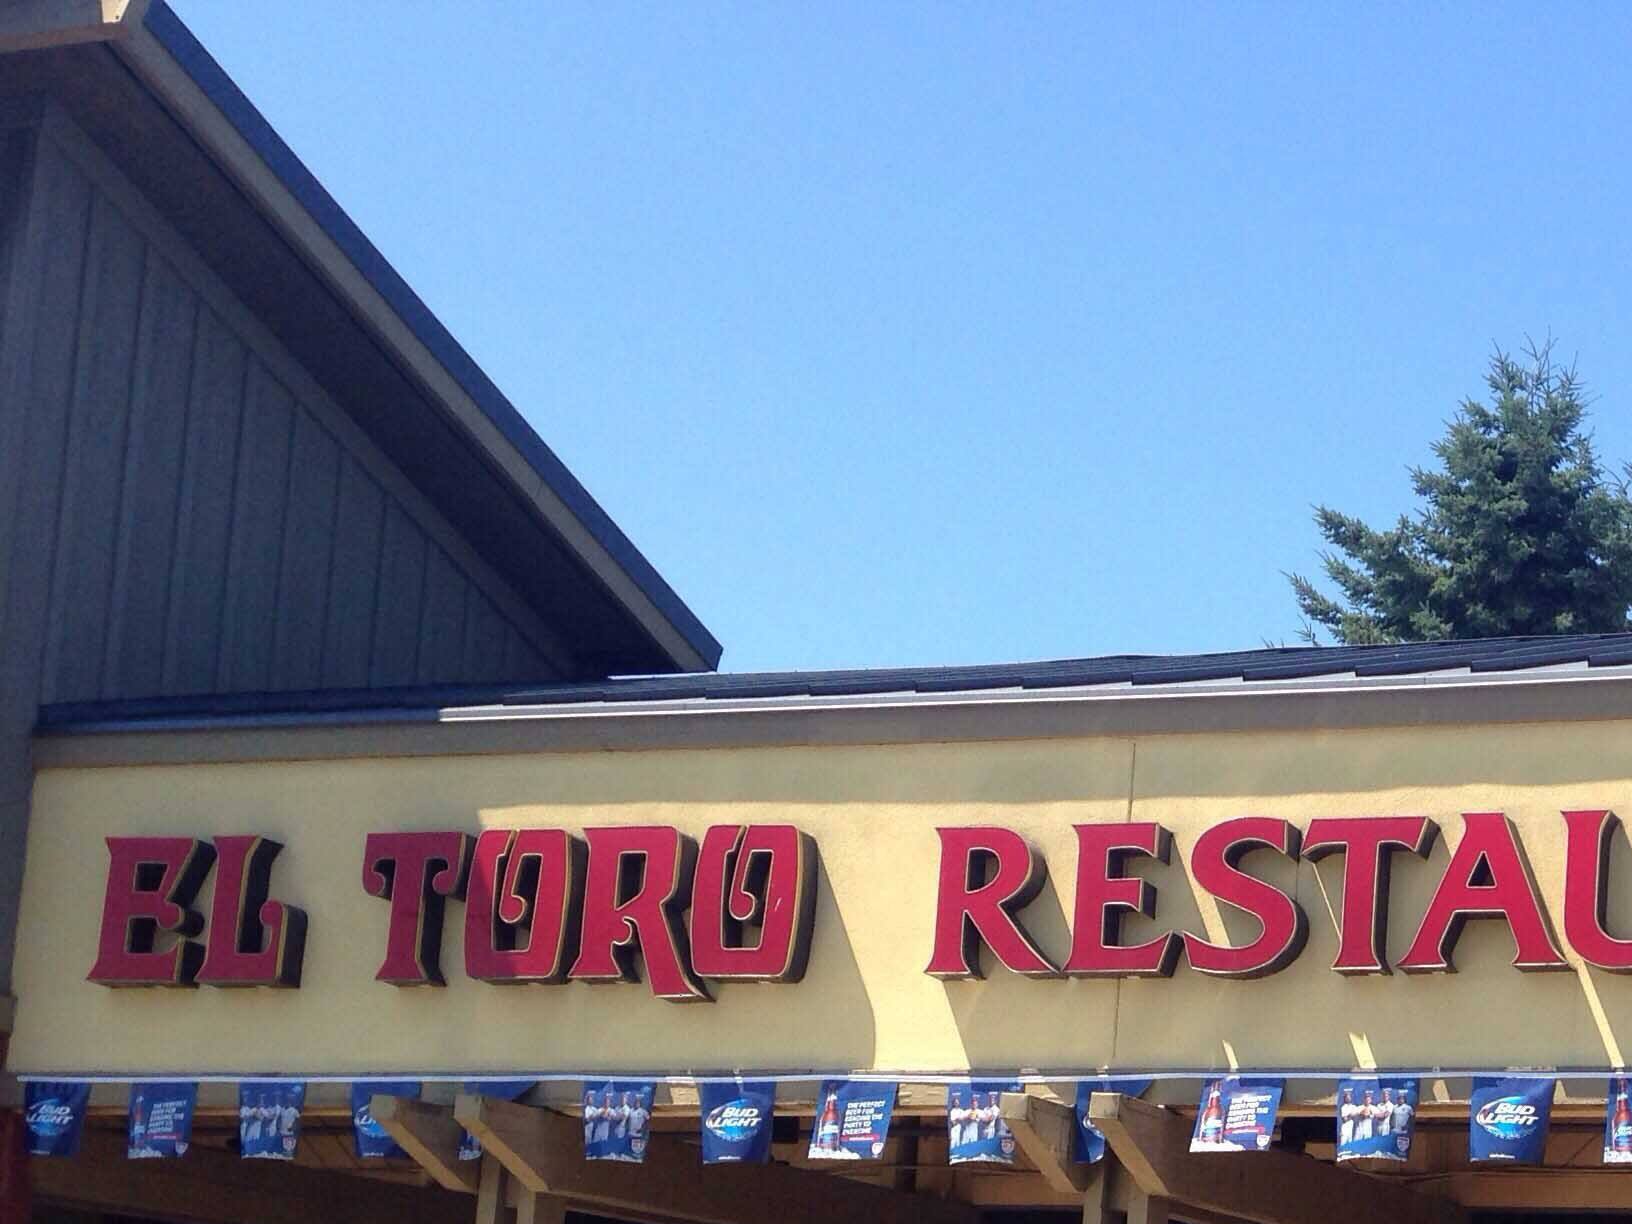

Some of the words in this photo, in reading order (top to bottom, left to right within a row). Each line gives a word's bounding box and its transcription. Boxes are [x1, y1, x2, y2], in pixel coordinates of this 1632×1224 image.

[85, 834, 304, 988] EL
[362, 824, 814, 1001] TORO
[722, 1107, 758, 1118] BUD
[1495, 1103, 1536, 1115] BUD
[713, 1117, 762, 1127] LIGHT
[1485, 1113, 1539, 1125] LIGHT
